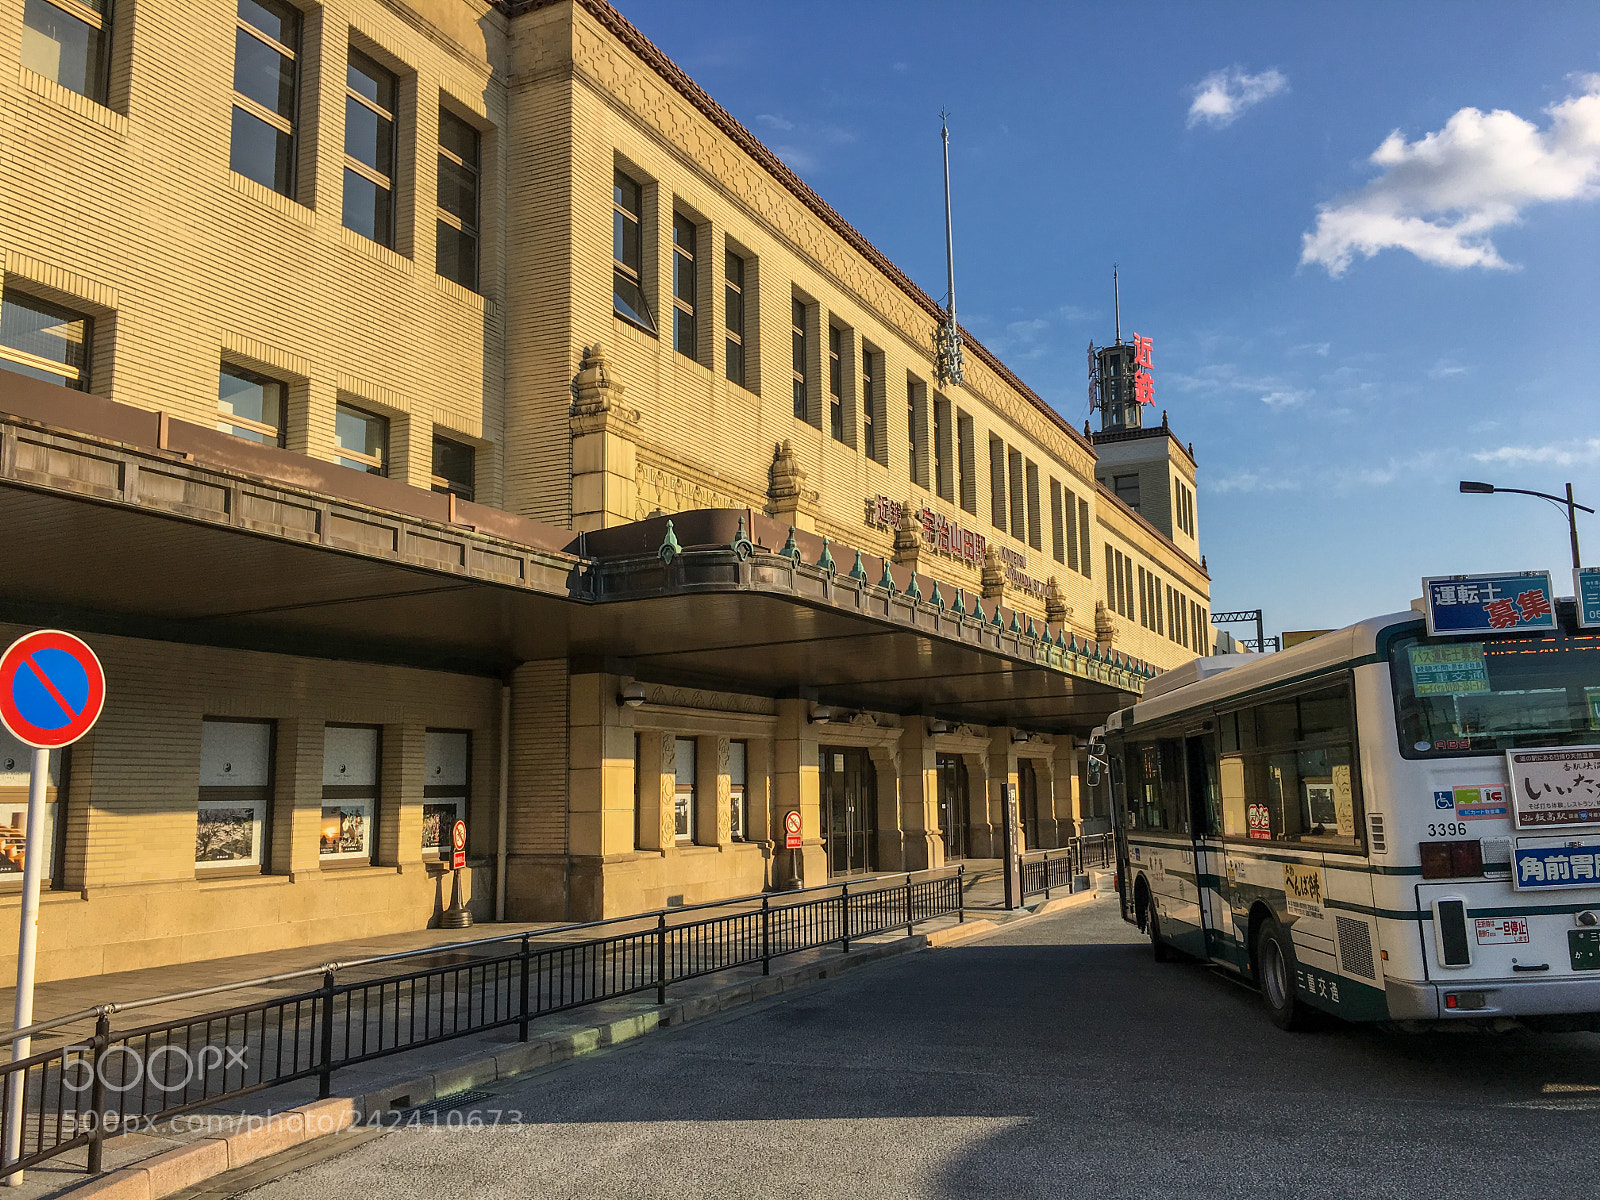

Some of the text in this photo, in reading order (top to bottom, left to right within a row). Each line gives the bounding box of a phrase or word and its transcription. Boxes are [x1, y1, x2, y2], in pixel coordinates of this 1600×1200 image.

[1133, 332, 1156, 407] 近鉄
[918, 507, 987, 570] 宇治山田駅
[1434, 583, 1502, 606] 運転士
[1483, 588, 1552, 630] 募集
[1417, 669, 1485, 684] 三重交通
[1434, 739, 1470, 750] ABS
[1427, 822, 1467, 837] 3396
[1494, 920, 1527, 936] 一旦停止
[1296, 970, 1340, 1003] 三重交通
